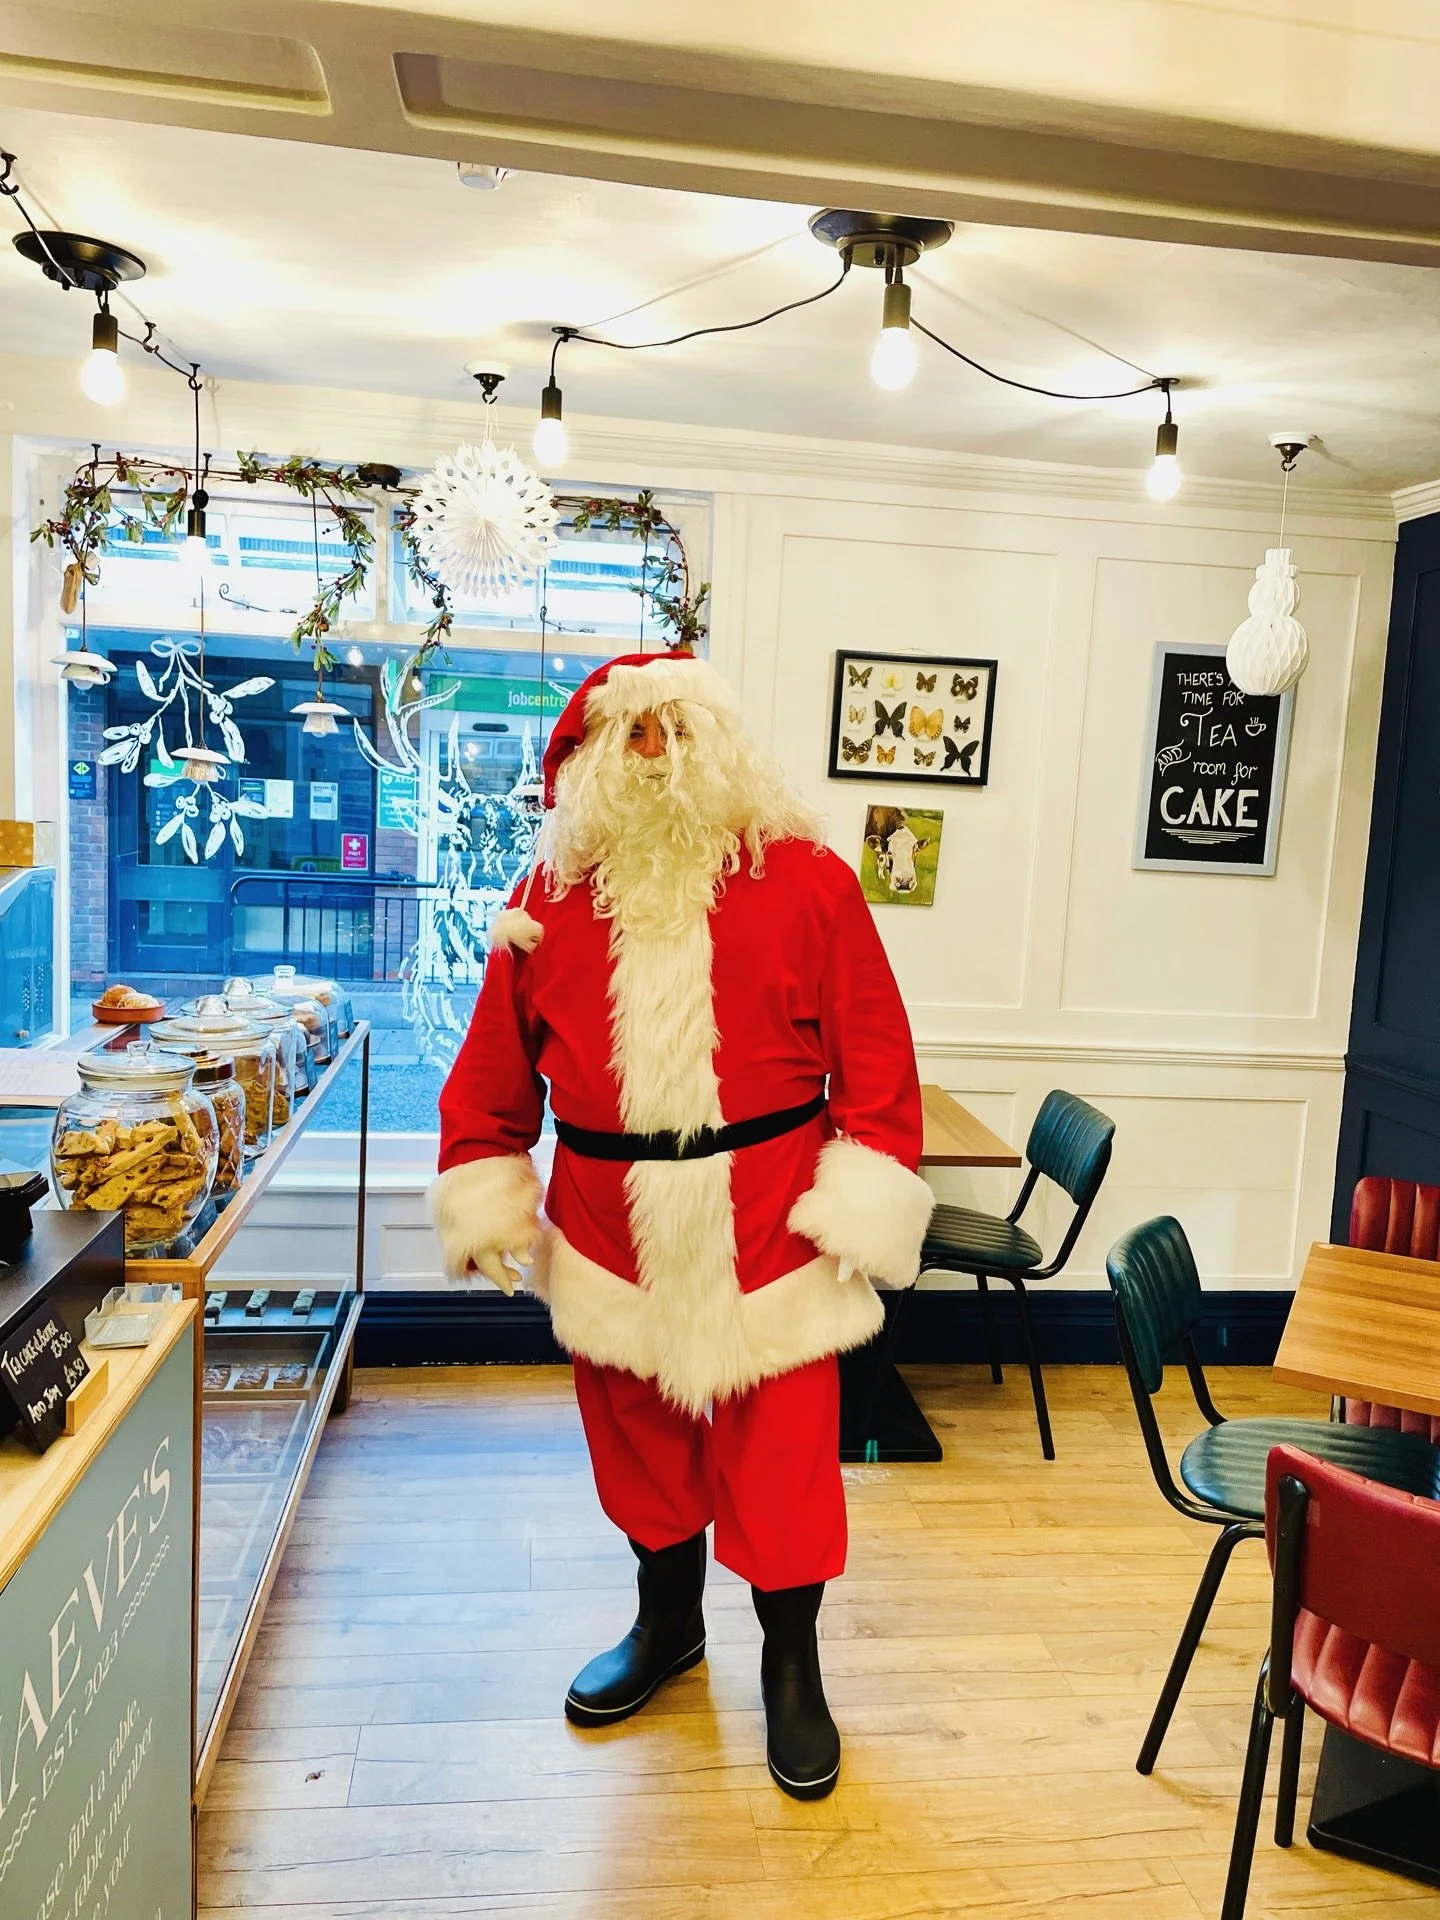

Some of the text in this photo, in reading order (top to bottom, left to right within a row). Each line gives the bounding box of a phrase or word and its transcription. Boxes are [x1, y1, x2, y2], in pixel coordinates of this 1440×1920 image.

[507, 690, 567, 708] jobcentre
[1176, 671, 1224, 688] THERE'S
[1181, 690, 1247, 707] TIME FOR
[1179, 707, 1237, 747] TEA
[1157, 747, 1183, 771] AND
[1193, 761, 1259, 786] room for
[1160, 785, 1260, 828] CAKE
[0, 1435, 171, 1820] AEVE'S
[42, 1628, 120, 1802] EST. 2023
[67, 1783, 94, 1870] find
[97, 1769, 106, 1801] a
[74, 1716, 153, 1918] table number
[103, 1824, 131, 1916] your
